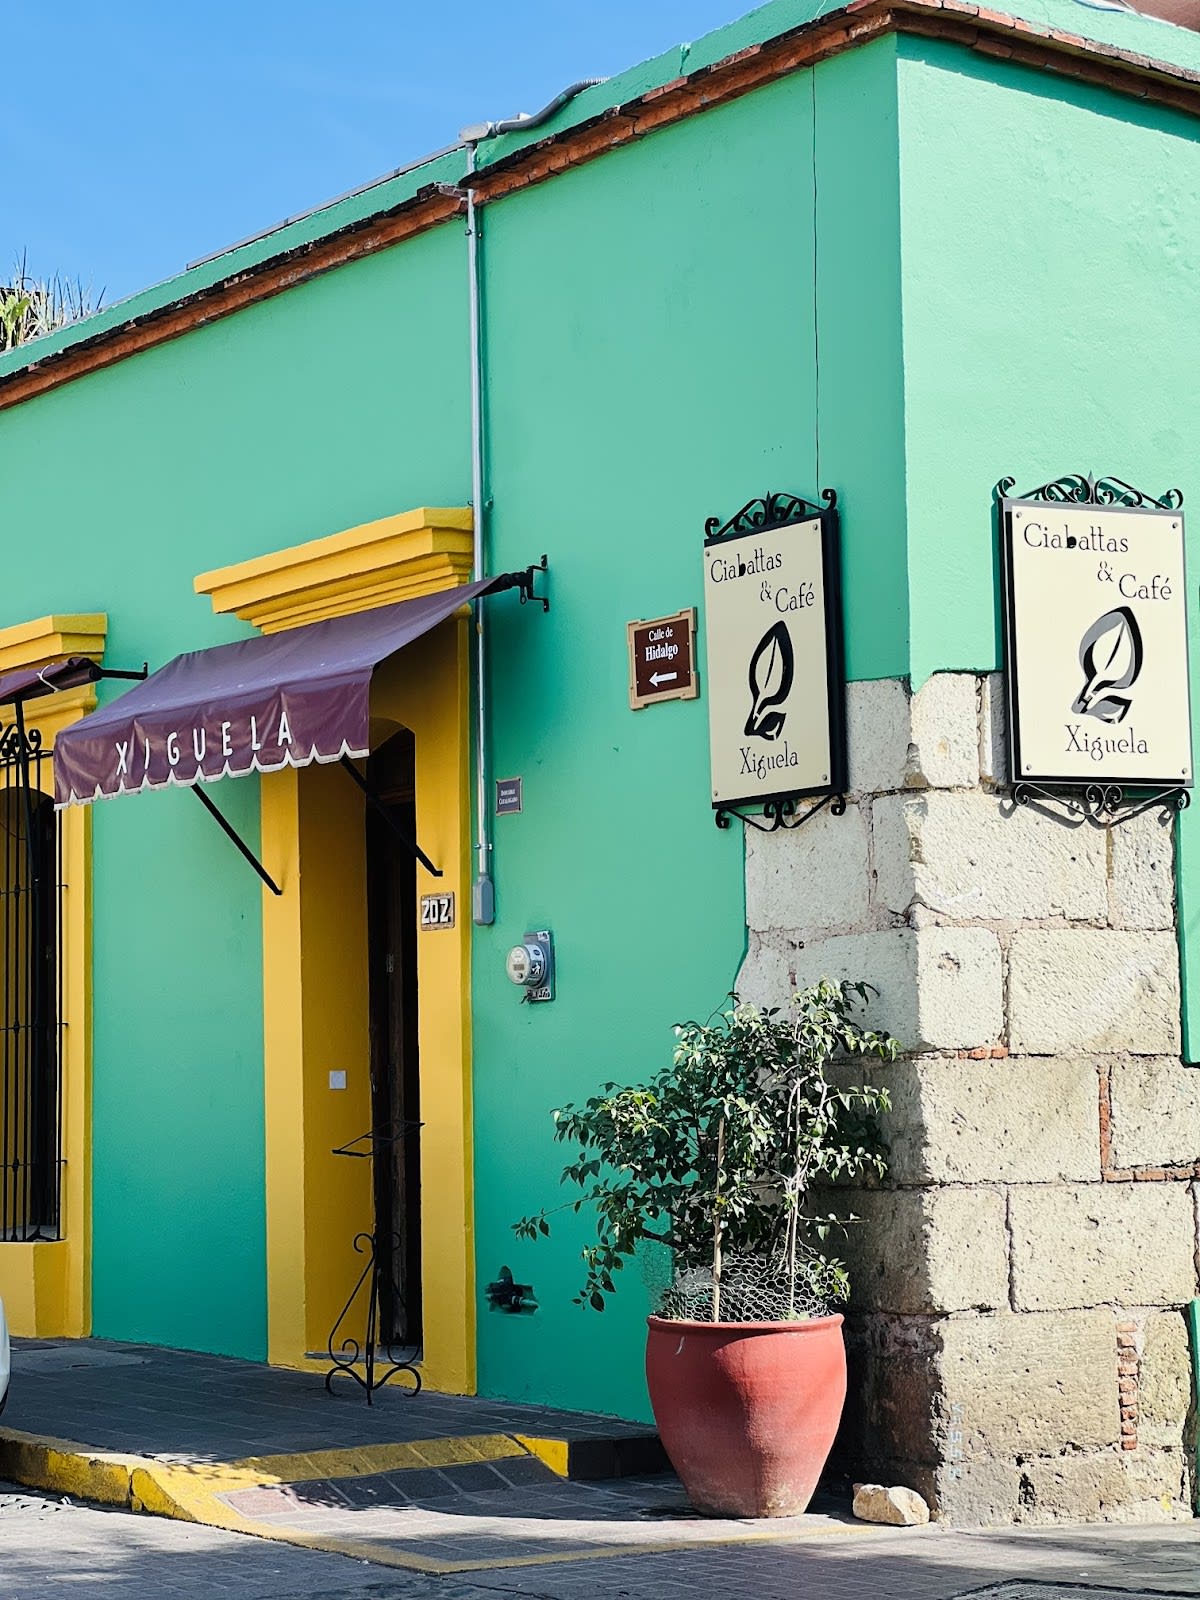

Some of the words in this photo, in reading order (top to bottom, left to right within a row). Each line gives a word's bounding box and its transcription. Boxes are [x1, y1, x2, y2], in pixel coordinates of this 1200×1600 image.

[1023, 522, 1129, 553] Ciabattas
[710, 547, 783, 584] Ciabattas
[1097, 560, 1115, 583] &
[1118, 573, 1172, 601] Café
[760, 580, 773, 602] &
[775, 582, 815, 613] Café
[645, 642, 679, 661] Hidalgo
[648, 628, 665, 642] Calle
[665, 626, 674, 638] de
[115, 711, 293, 776] XIGUELA
[1065, 724, 1150, 761] Xiguela
[739, 741, 799, 780] Xiguela
[421, 898, 449, 924] 202
